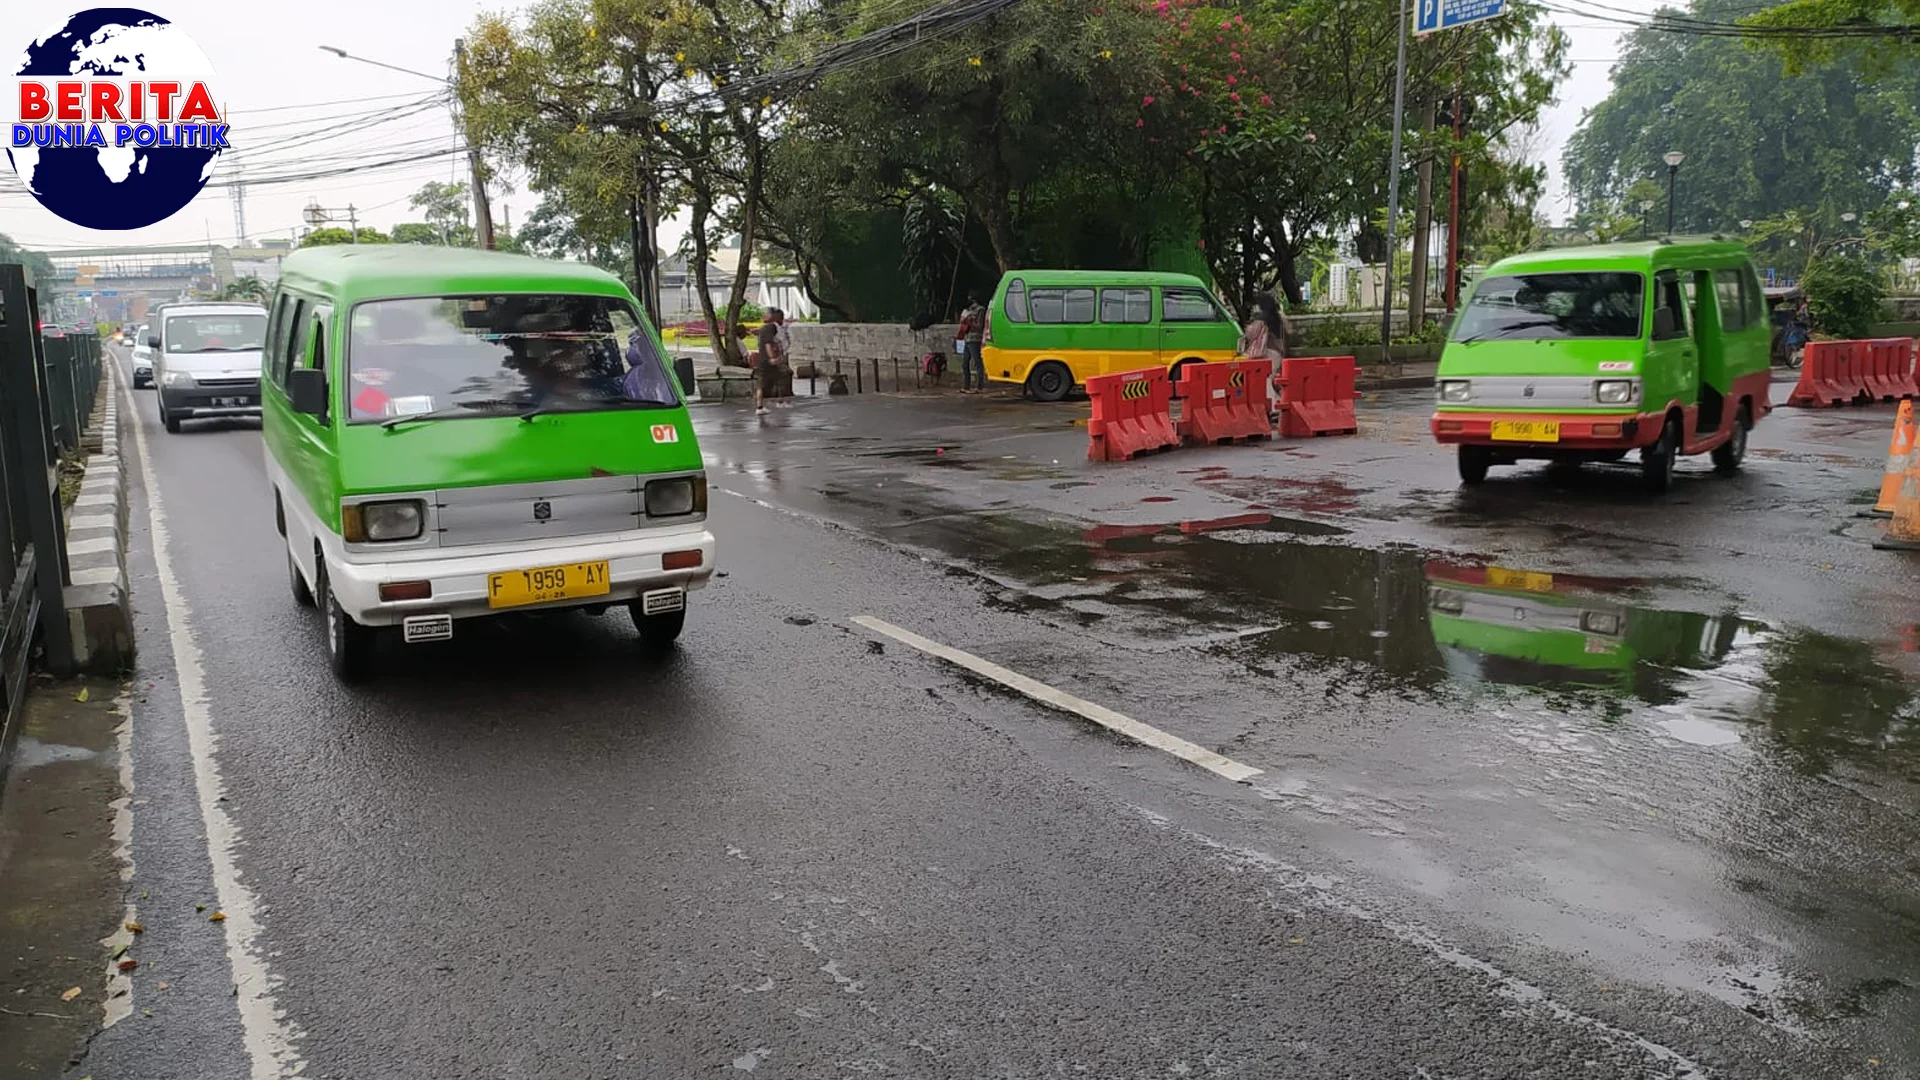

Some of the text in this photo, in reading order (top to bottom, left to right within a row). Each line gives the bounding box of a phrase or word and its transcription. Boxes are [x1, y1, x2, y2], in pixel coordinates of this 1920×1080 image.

[1423, 0, 1433, 25] P
[653, 425, 674, 441] 07
[493, 563, 605, 597] F 1959 AY
[409, 623, 449, 635] Halogen
